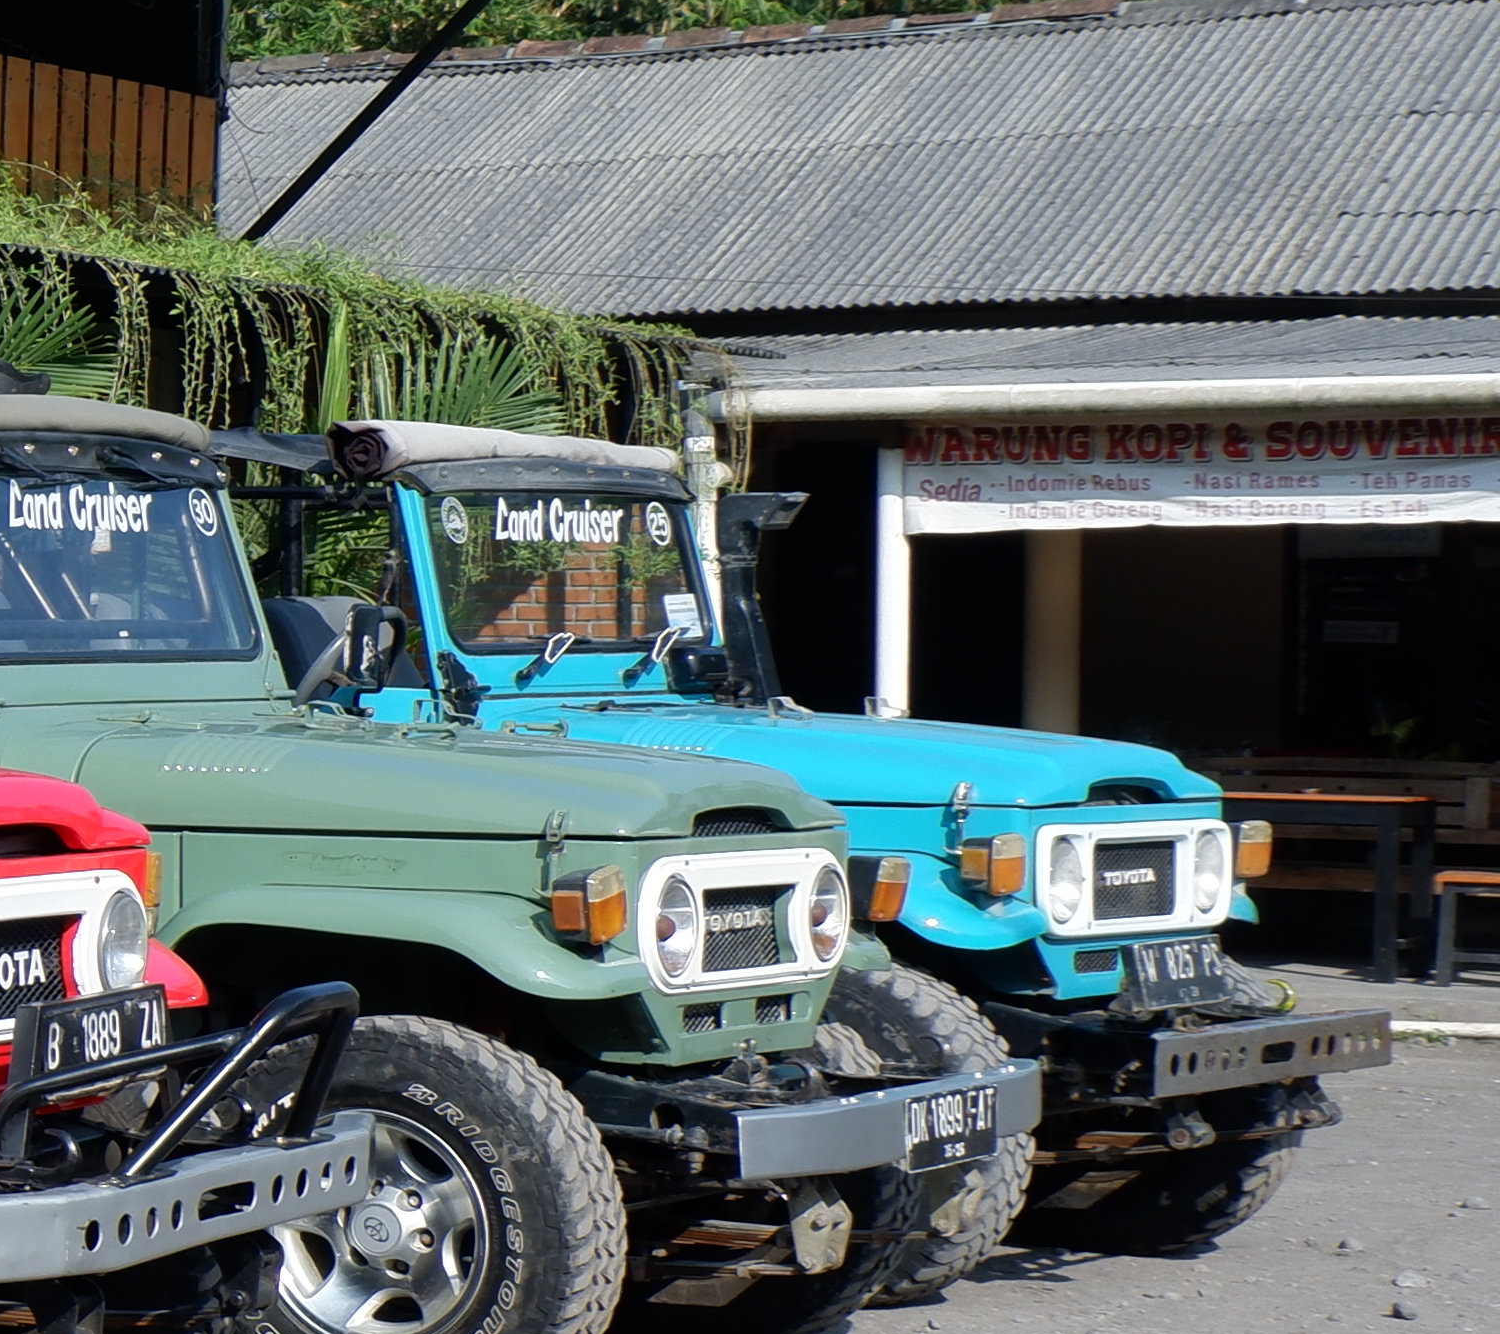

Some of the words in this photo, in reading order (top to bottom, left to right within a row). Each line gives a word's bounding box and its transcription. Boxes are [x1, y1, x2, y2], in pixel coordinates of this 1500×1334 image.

[904, 425, 1095, 465] WARUNG
[1105, 423, 1213, 464] KOPI
[1222, 422, 1252, 462] &
[919, 477, 983, 501] Sedia
[1091, 473, 1152, 491] Rebus
[1249, 471, 1321, 489] Rames
[1405, 471, 1472, 489] Panas
[69, 481, 153, 533] Cruiser
[191, 497, 214, 526] 30
[495, 496, 543, 541] Land
[549, 497, 624, 543] Cruiser
[649, 512, 669, 537] 25
[1103, 867, 1157, 888] TOYOTA
[704, 907, 770, 932] TOYOTA
